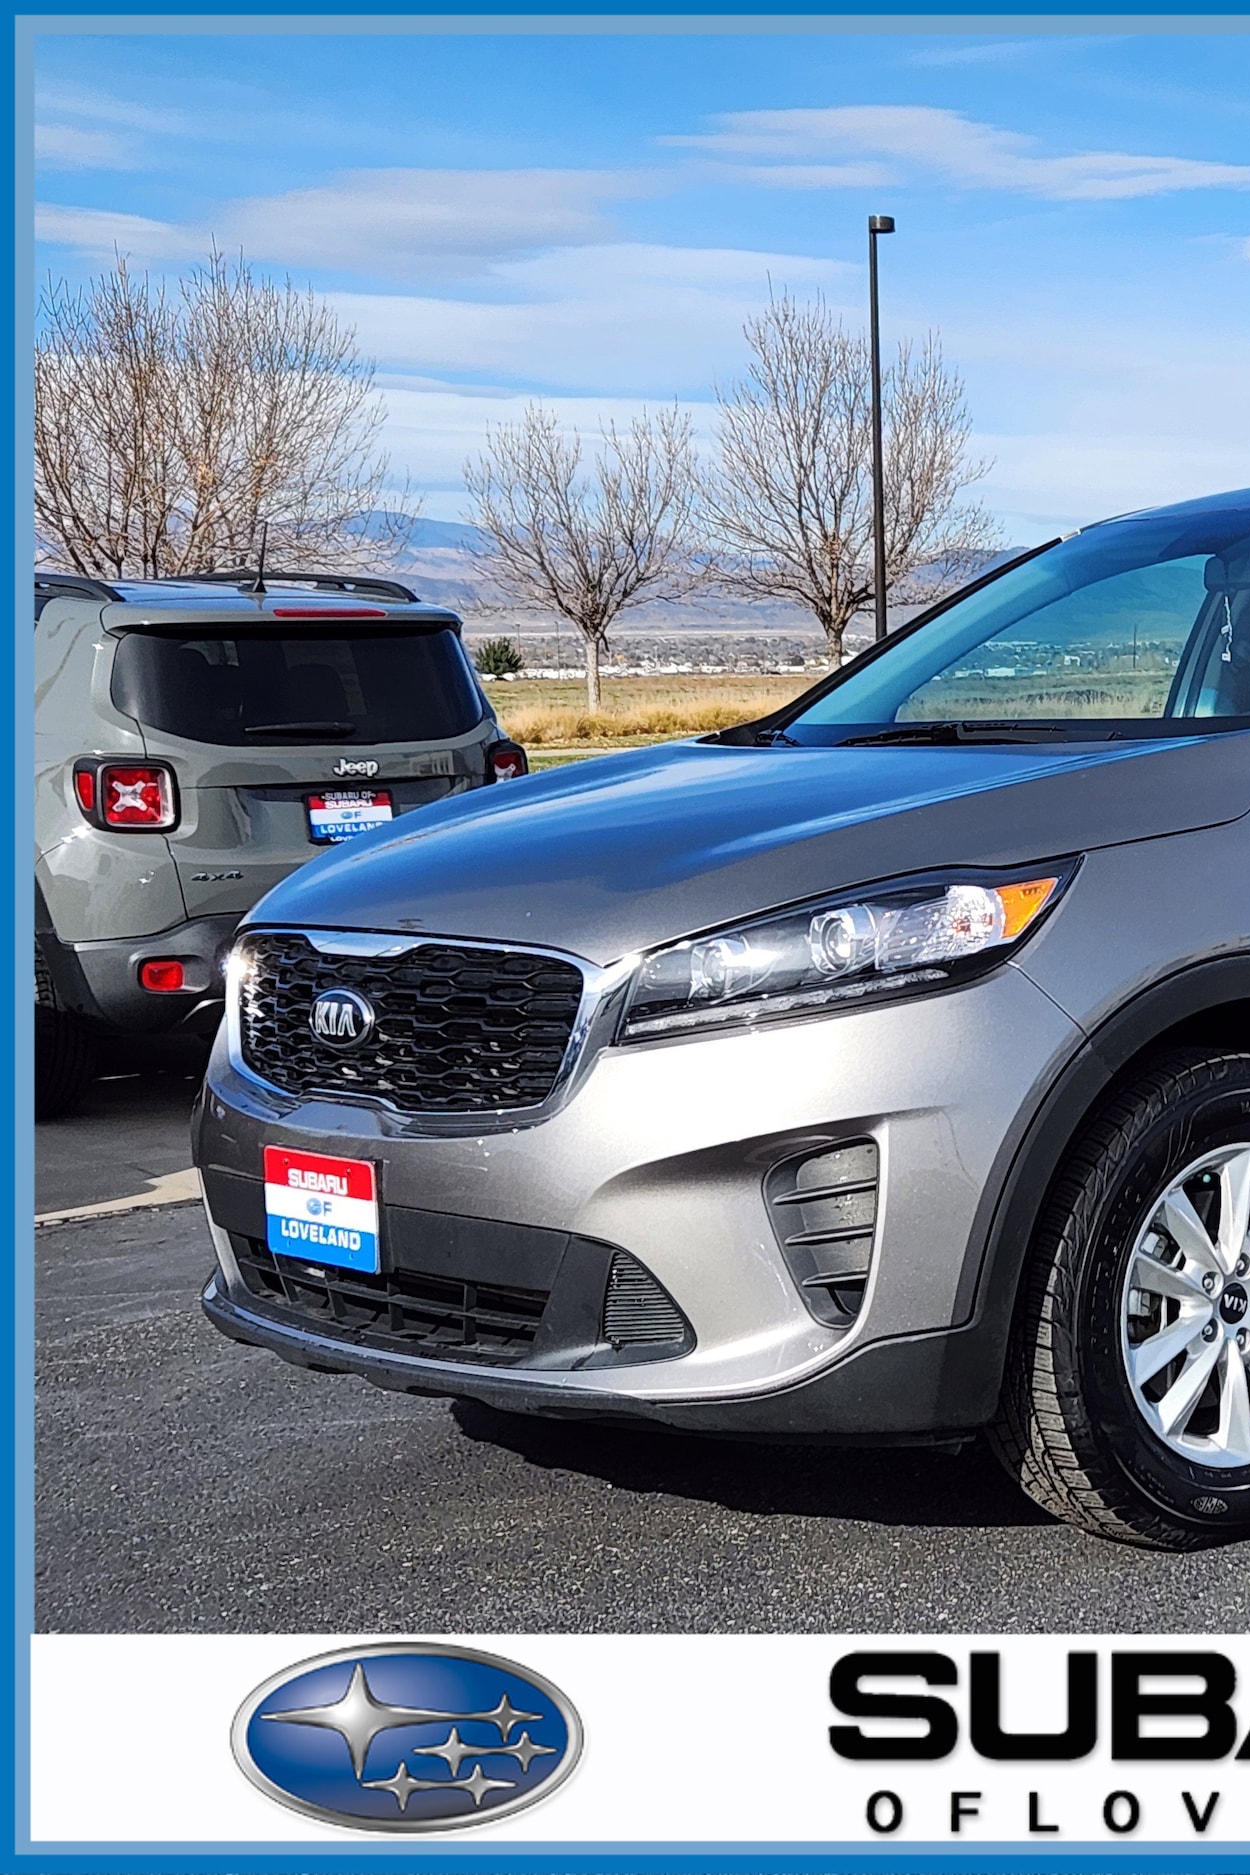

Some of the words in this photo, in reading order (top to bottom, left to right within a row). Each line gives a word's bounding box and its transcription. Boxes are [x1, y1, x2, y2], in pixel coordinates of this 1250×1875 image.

[333, 758, 379, 777] Jeep
[324, 792, 359, 801] SUBARU
[315, 1001, 357, 1037] KIA
[287, 1167, 349, 1196] SUBARU
[281, 1218, 362, 1252] LOVELAND
[1223, 1293, 1247, 1314] KIA
